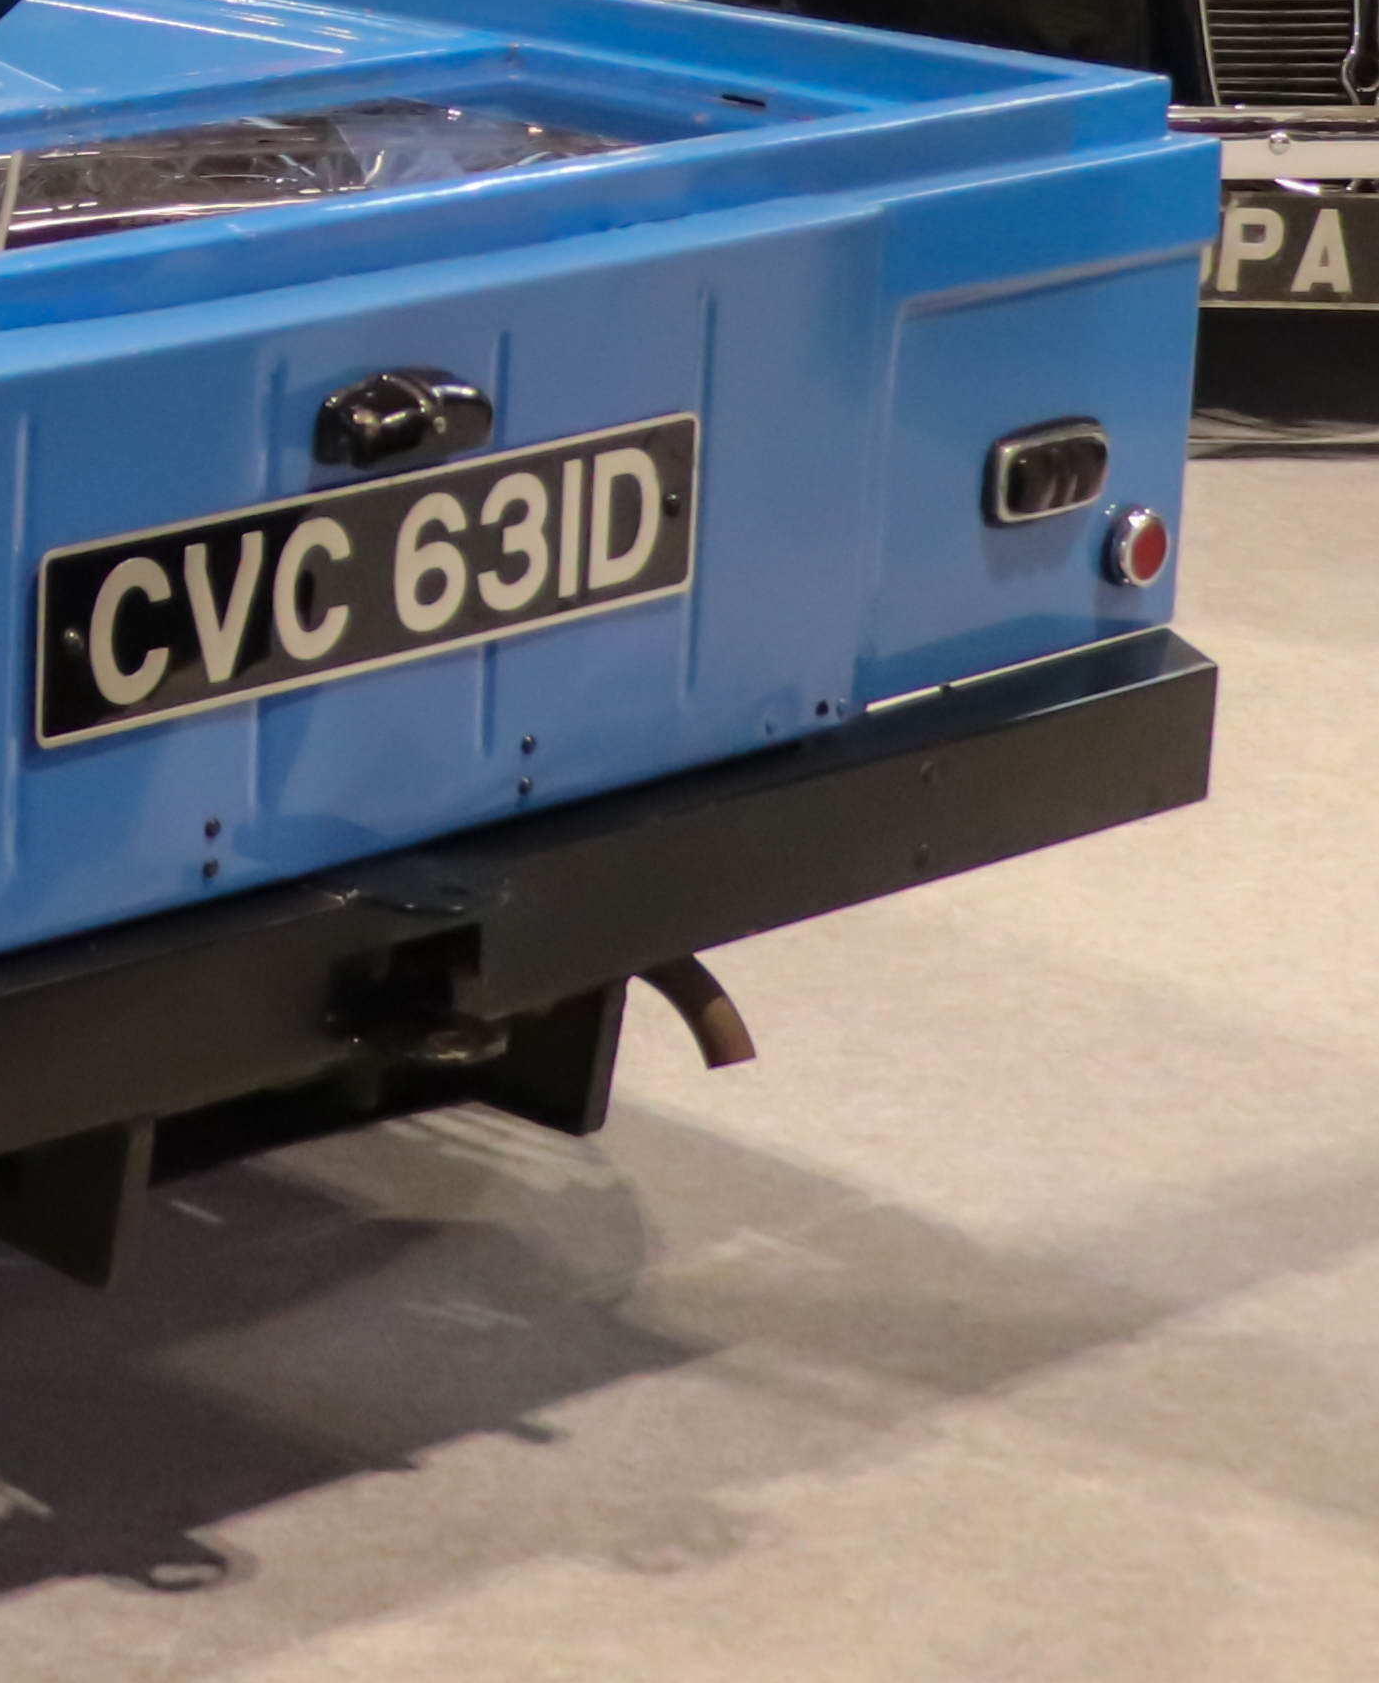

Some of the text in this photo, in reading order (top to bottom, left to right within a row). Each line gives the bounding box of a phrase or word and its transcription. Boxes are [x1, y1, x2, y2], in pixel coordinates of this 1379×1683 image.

[1199, 207, 1353, 292] PA
[88, 447, 661, 706] CVC 631D
